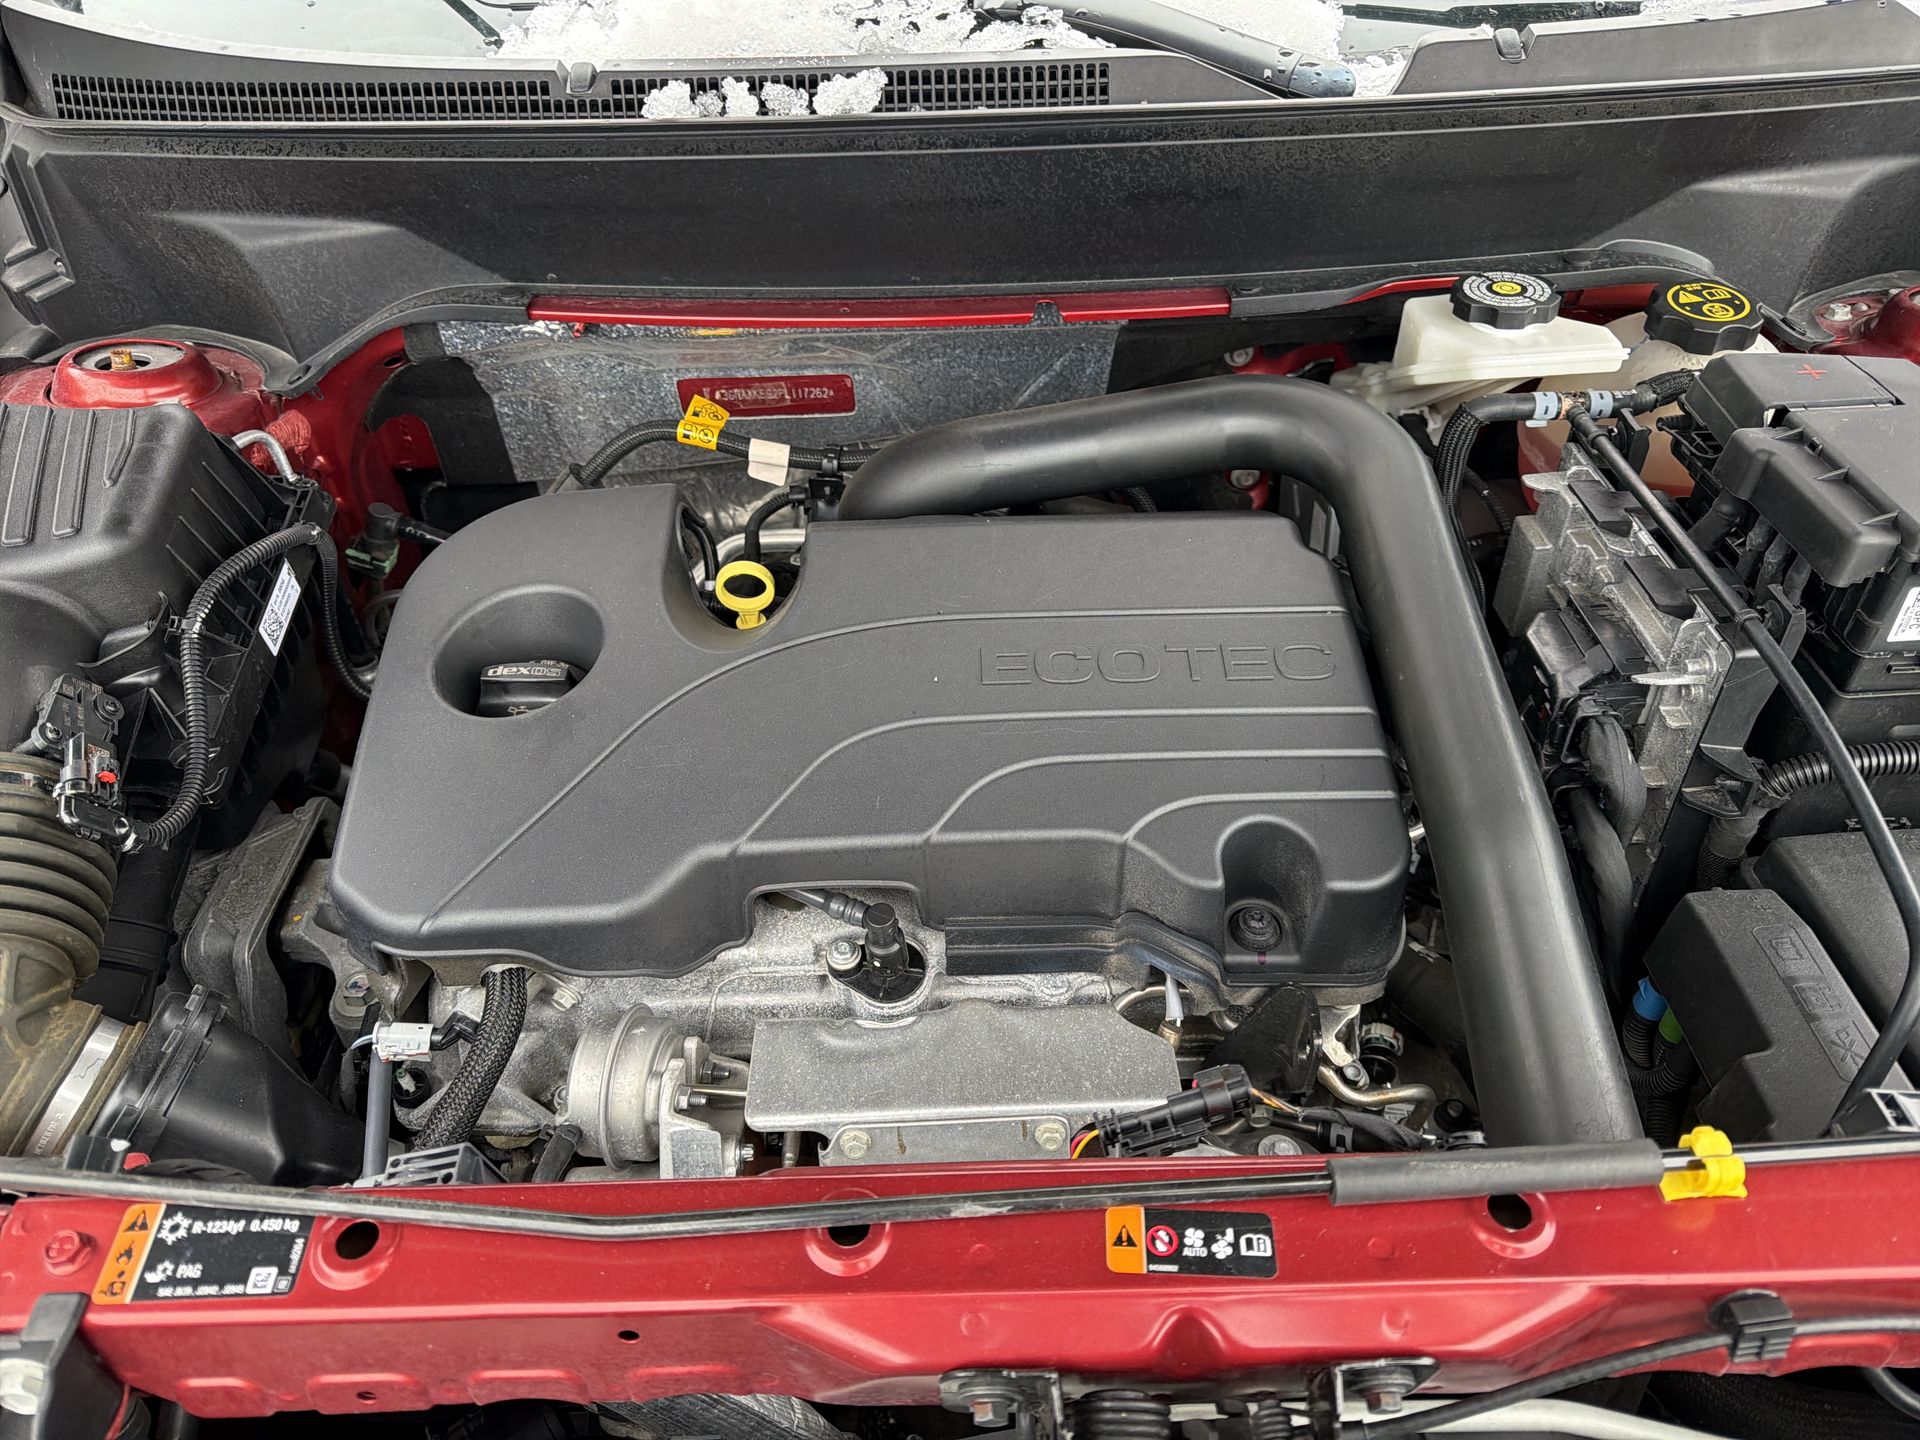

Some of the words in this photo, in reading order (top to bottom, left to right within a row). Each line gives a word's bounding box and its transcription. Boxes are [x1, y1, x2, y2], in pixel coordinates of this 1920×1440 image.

[487, 665, 562, 678] dexos
[979, 643, 1337, 685] ECOTEC
[191, 1219, 246, 1235] R-1234yf
[249, 1218, 283, 1232] 0.450
[283, 1218, 300, 1233] kg
[1182, 1247, 1208, 1257] AUTO
[176, 1263, 203, 1279] PAG
